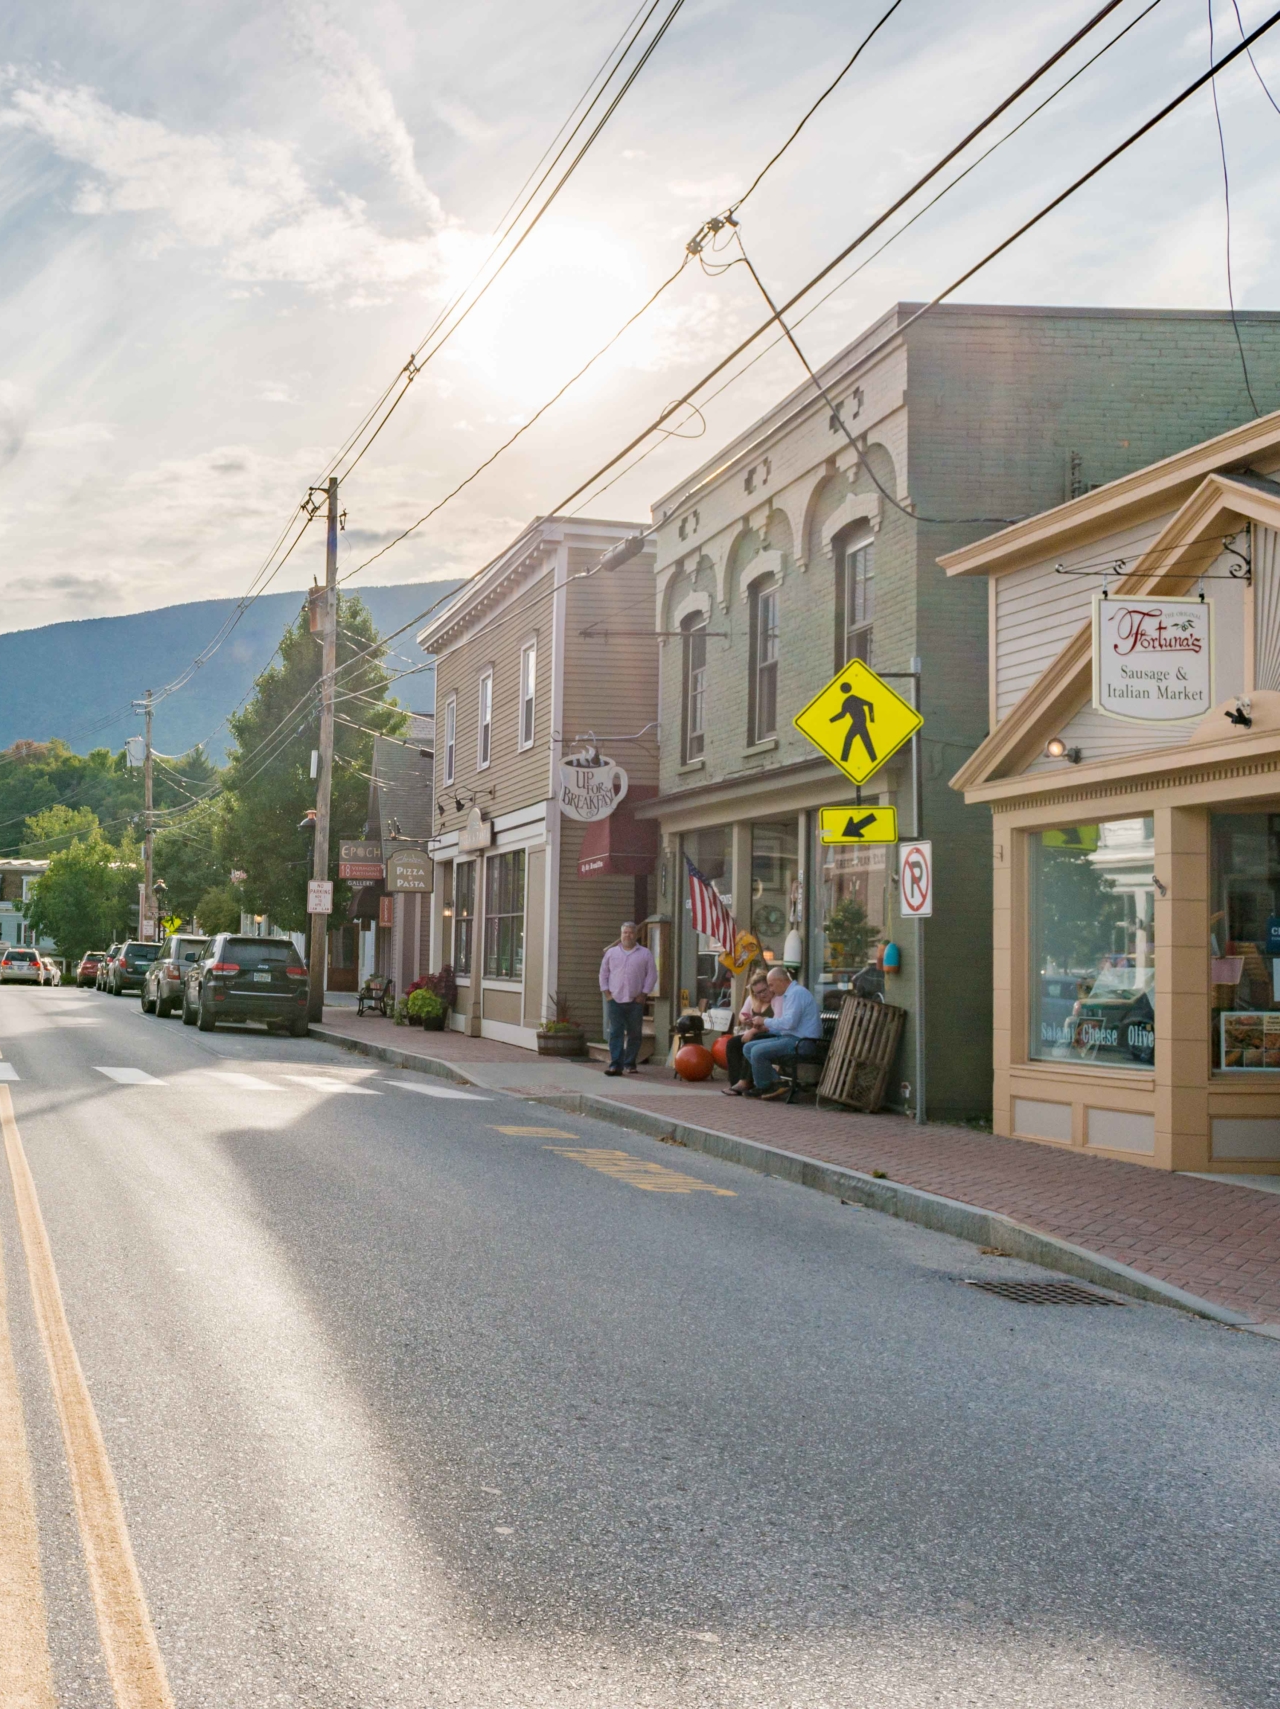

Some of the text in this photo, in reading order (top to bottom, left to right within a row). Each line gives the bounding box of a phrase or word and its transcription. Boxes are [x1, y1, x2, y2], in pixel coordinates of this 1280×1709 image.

[1175, 611, 1202, 620] ORIGINAL
[1108, 607, 1202, 656] Fortuna's
[1120, 664, 1189, 682] Sausage &
[1107, 683, 1203, 701] Italian Market
[575, 770, 594, 790] UP
[586, 782, 609, 795] FOR
[562, 786, 616, 813] BREAKFAST
[341, 845, 381, 859] EPOCH
[341, 864, 351, 877] 18
[396, 866, 425, 875] PIZZA
[397, 879, 425, 888] PASTA
[1041, 1022, 1076, 1041] Salami
[1081, 1024, 1118, 1046] Cheese
